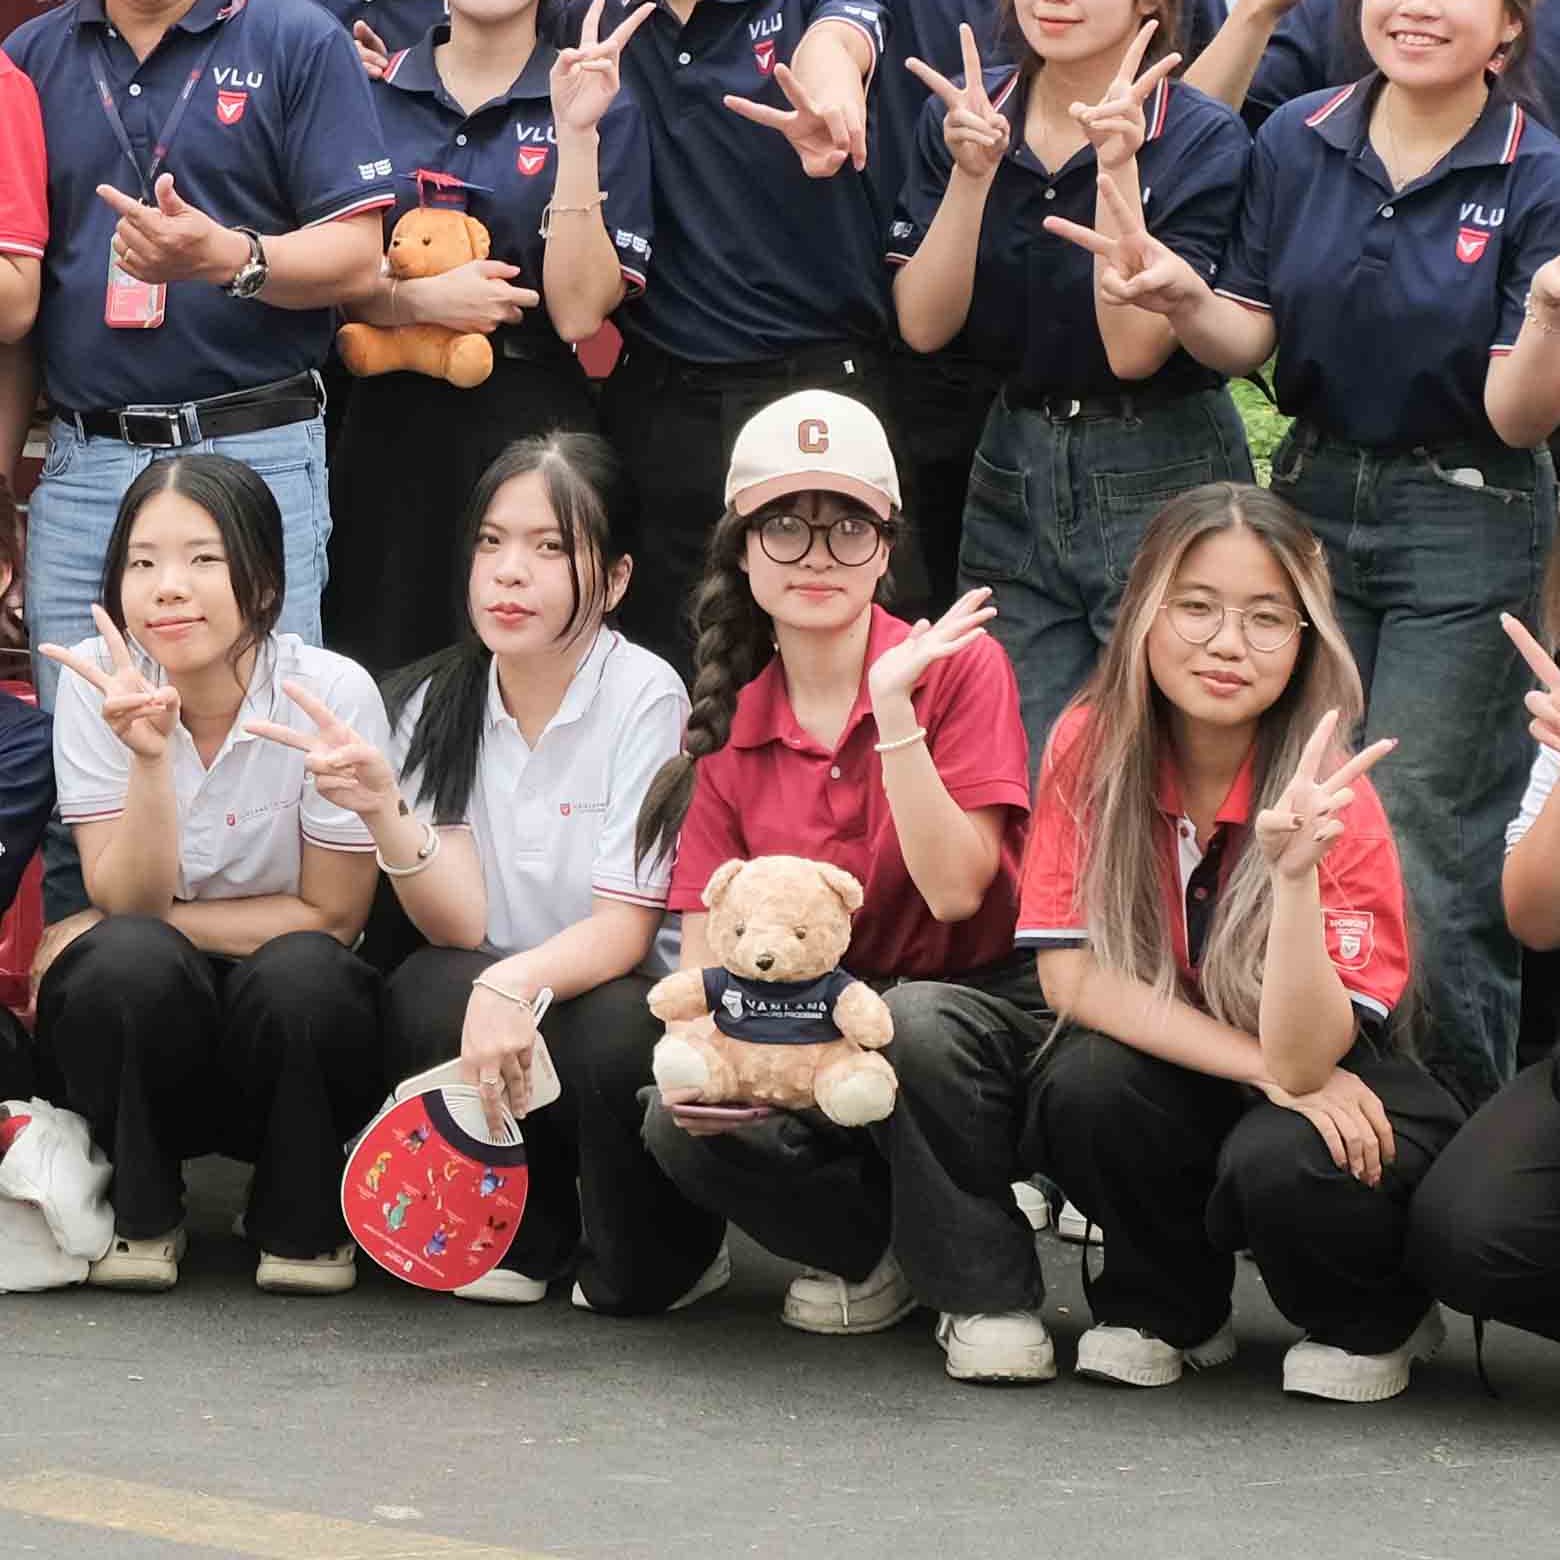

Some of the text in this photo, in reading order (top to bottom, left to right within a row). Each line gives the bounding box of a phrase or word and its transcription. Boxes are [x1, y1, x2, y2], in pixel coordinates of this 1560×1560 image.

[749, 12, 783, 40] VLU
[212, 66, 264, 89] VLU
[1458, 202, 1506, 228] VLU
[798, 418, 830, 454] C
